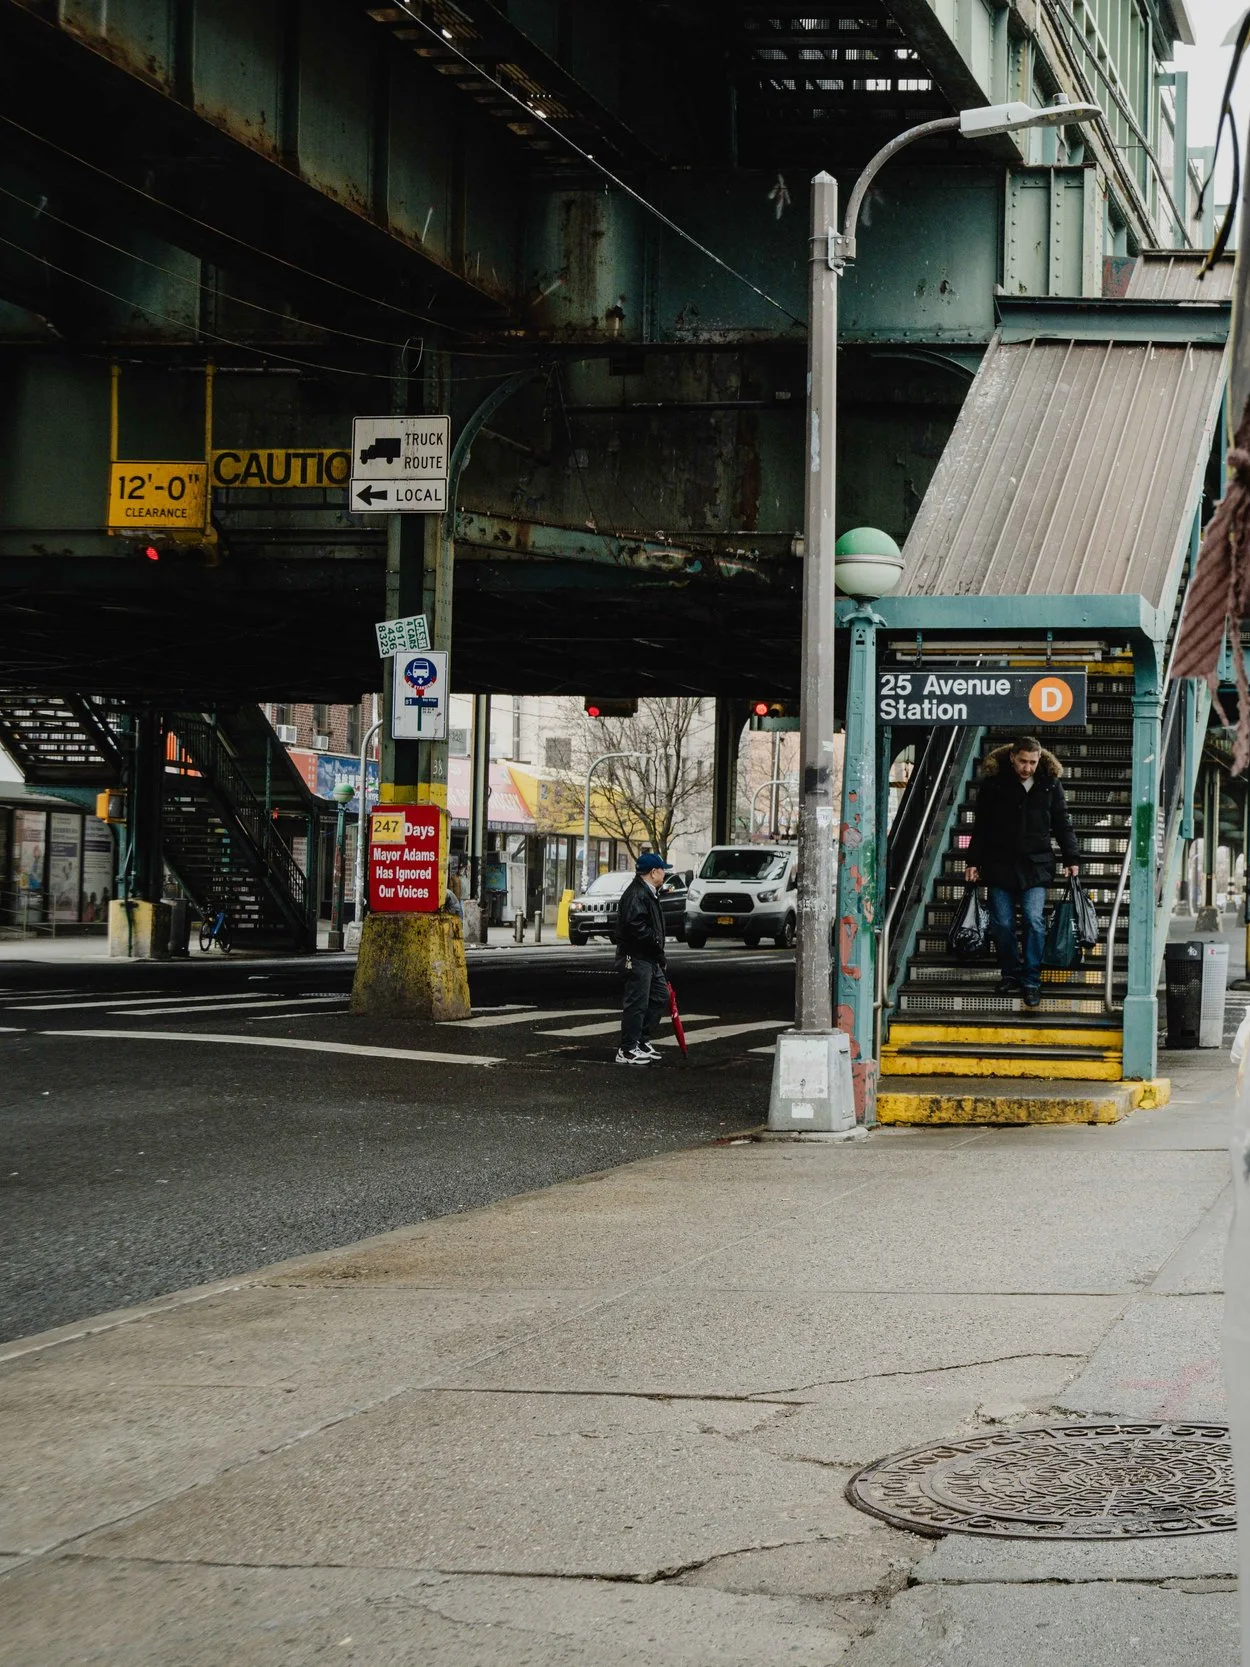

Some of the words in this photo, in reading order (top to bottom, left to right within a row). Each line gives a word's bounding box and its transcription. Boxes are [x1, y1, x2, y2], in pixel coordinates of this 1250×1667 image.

[405, 432, 444, 446] TRUCK
[213, 451, 351, 485] CAUTIO
[404, 456, 443, 469] ROUTE
[118, 473, 199, 500] 12'-0"
[396, 488, 442, 502] LOCAL
[125, 507, 188, 519] CLEARANCE
[378, 625, 390, 655] 8323
[387, 628, 398, 650] 436
[394, 621, 408, 651] (917
[407, 628, 418, 650] CARS
[414, 618, 427, 649] CASH
[880, 675, 912, 695] 25
[923, 675, 1011, 695] Avenue
[880, 698, 968, 720] Station
[1041, 687, 1063, 713] D
[374, 820, 399, 833] 247
[404, 823, 435, 840] Days
[373, 847, 401, 864] Mayor
[403, 848, 435, 861] Adams
[376, 866, 393, 879] Has
[396, 866, 432, 882] Ignored
[378, 884, 395, 898] Our
[397, 885, 429, 898] Voices
